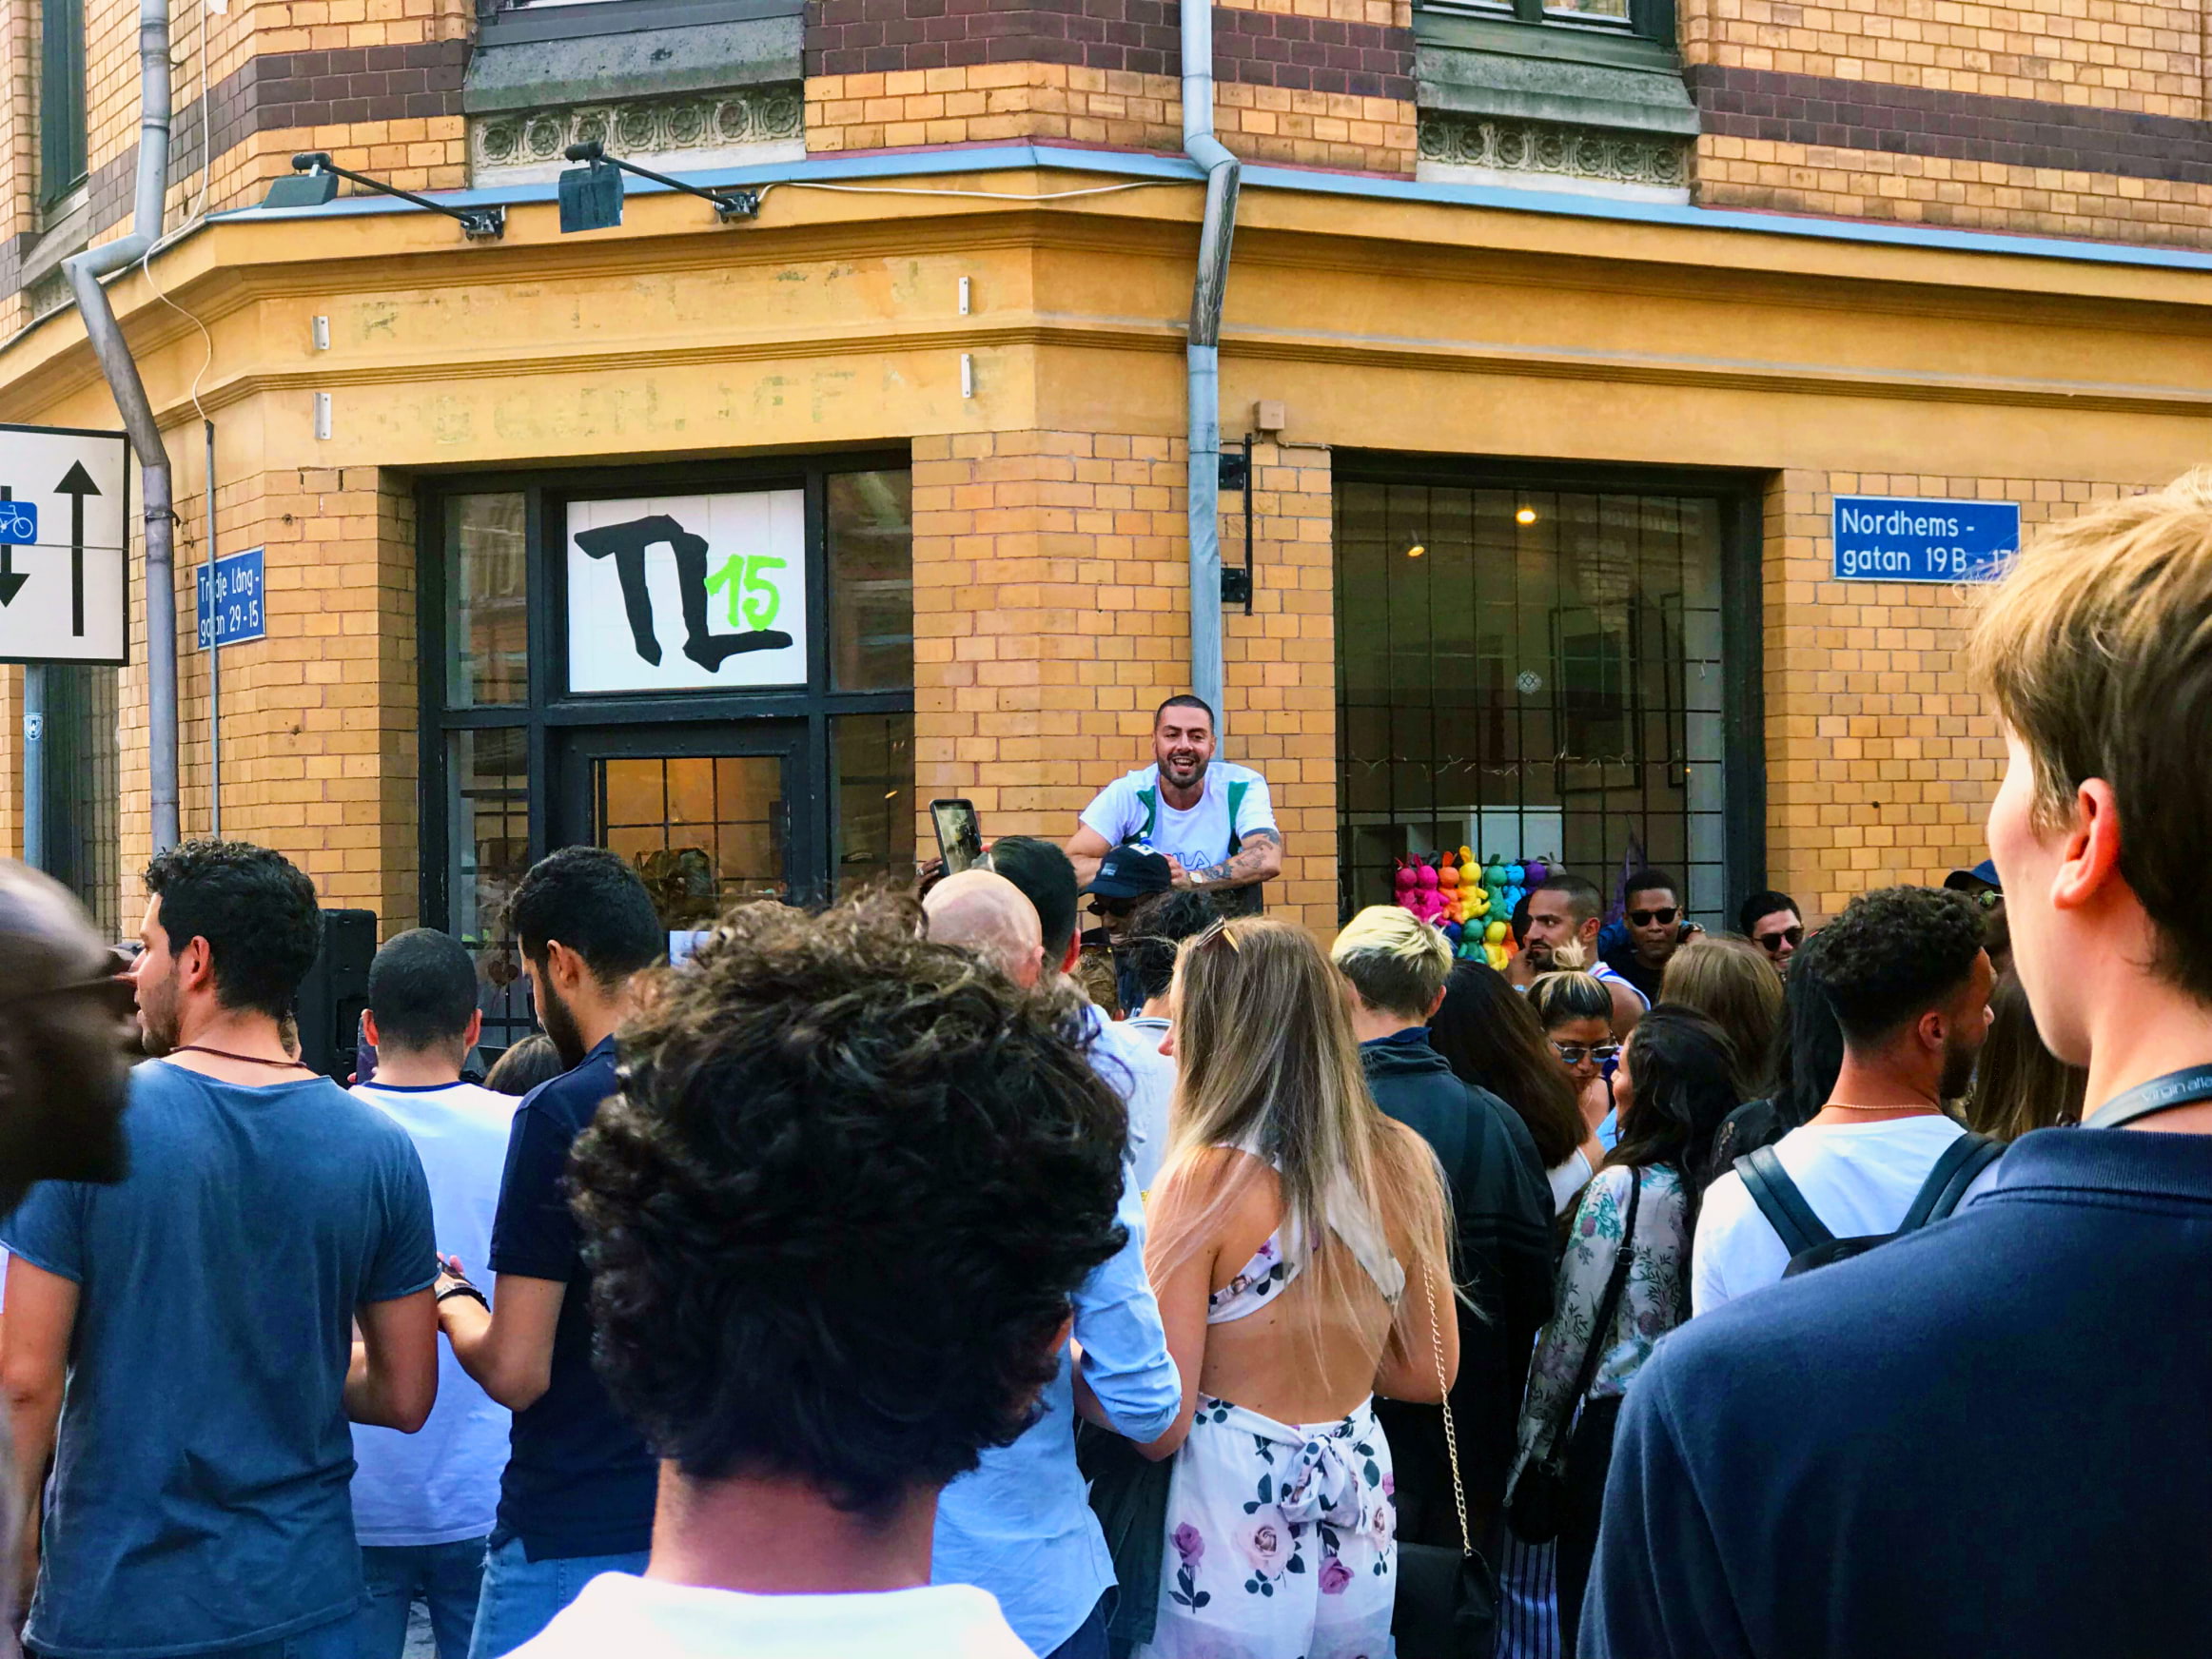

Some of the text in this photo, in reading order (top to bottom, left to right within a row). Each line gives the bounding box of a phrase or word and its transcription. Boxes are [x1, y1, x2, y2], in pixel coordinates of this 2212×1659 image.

[1843, 546, 1911, 575] gatan
[199, 571, 227, 603] Trdje
[703, 553, 788, 632] 15
[200, 615, 225, 645] gaan
[1163, 849, 1211, 872] ILA
